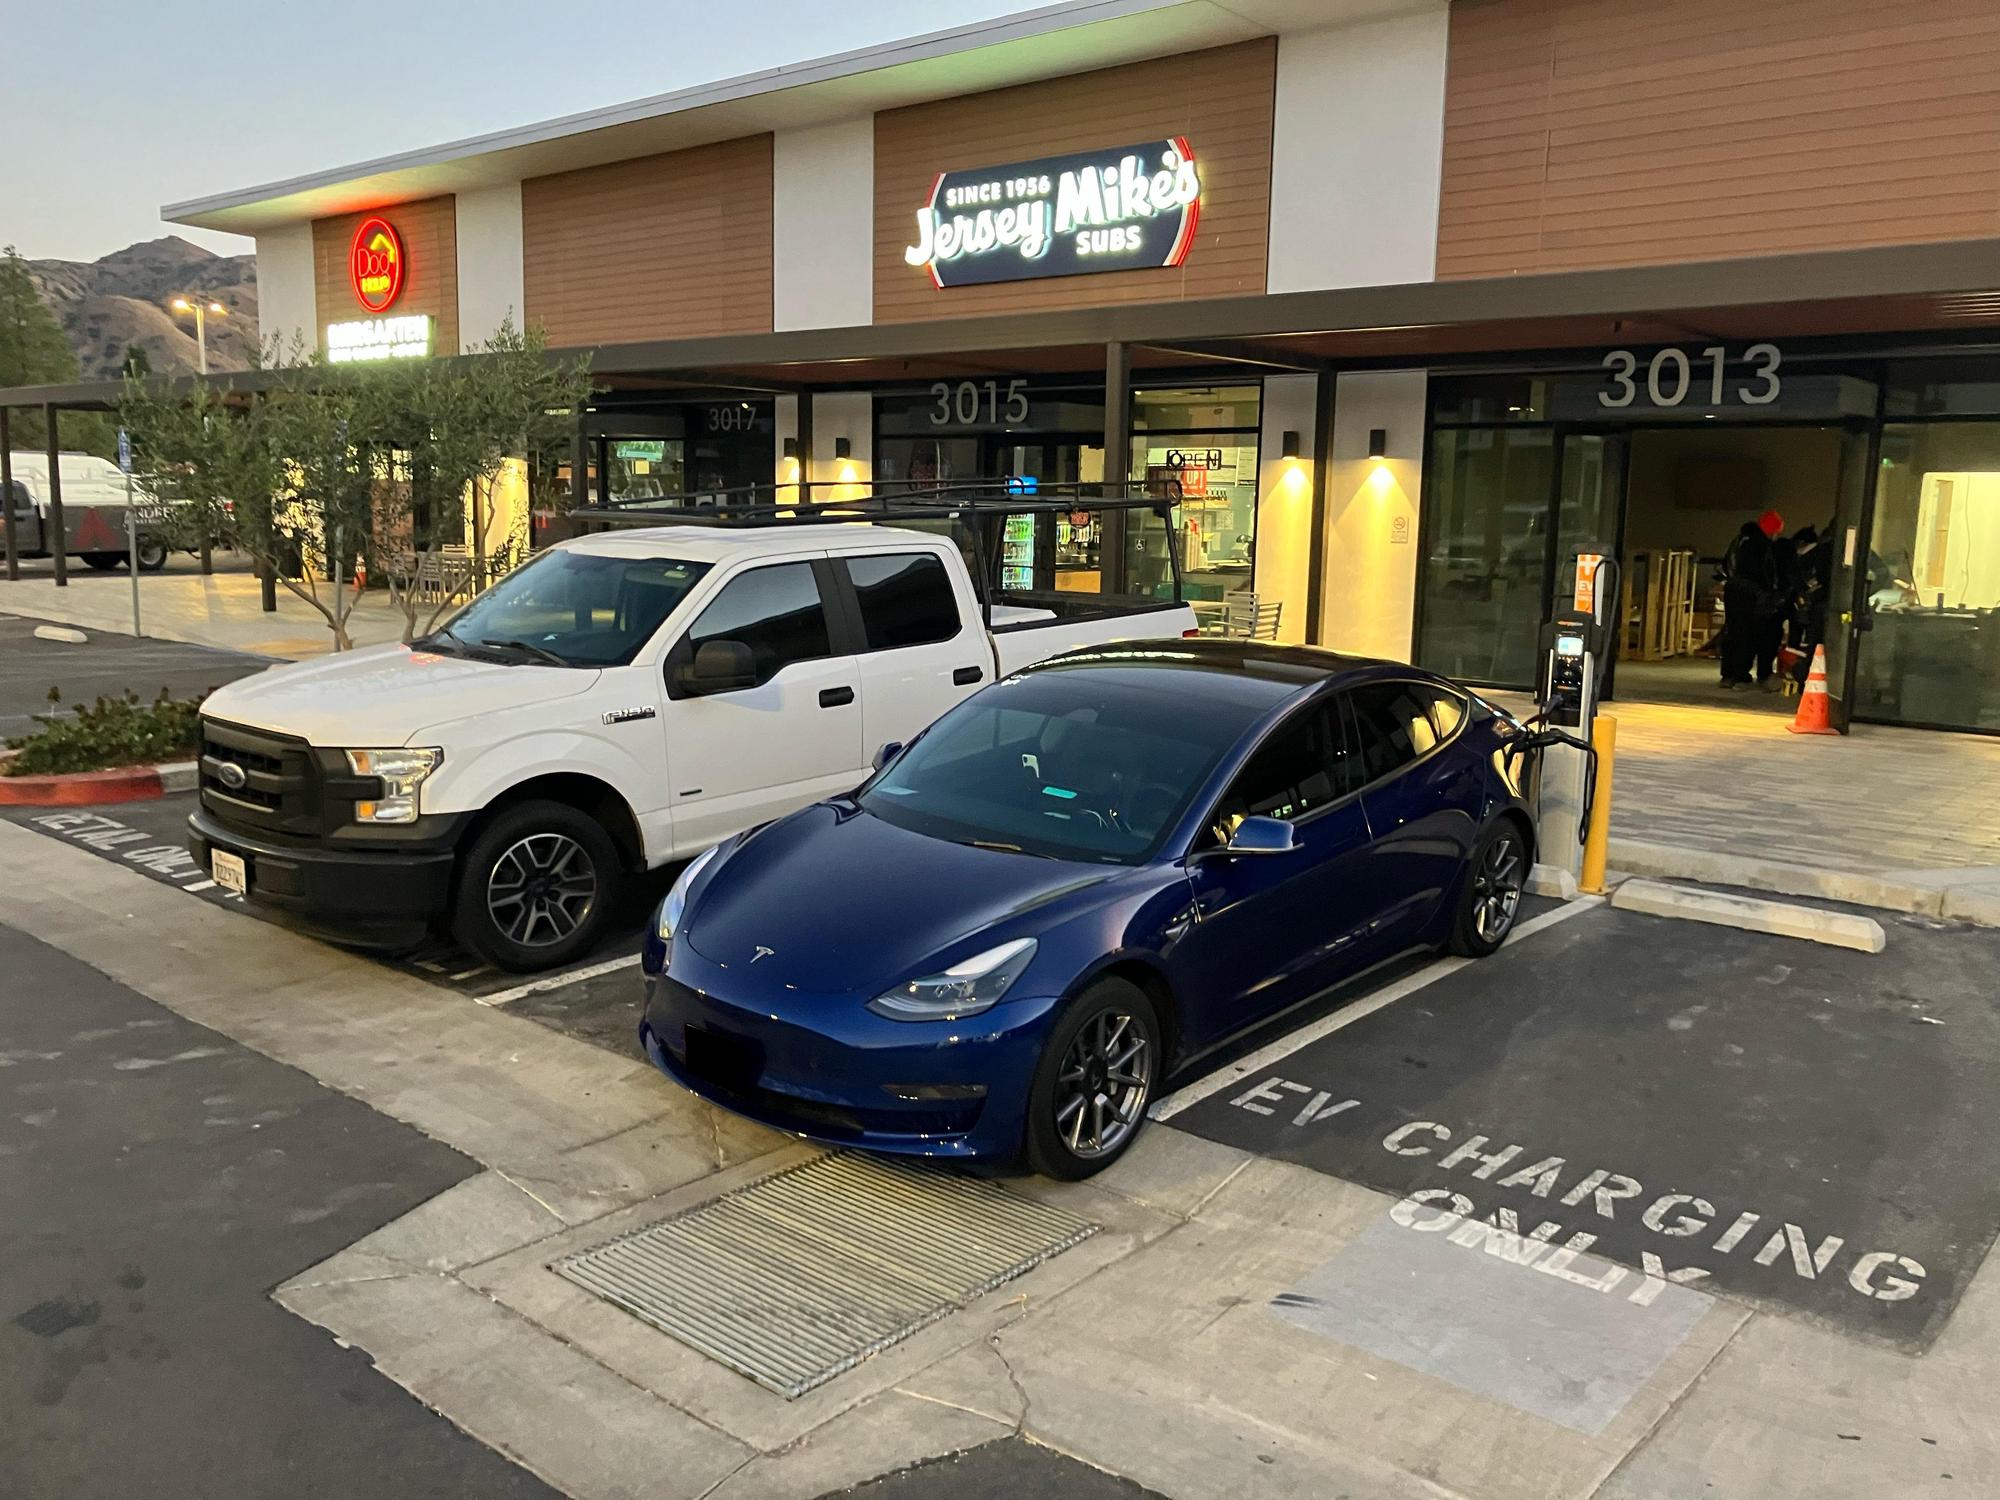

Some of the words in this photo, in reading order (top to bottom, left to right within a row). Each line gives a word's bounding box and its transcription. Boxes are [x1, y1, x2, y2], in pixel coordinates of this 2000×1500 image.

[905, 200, 1047, 266] Jersey
[1054, 150, 1199, 233] Mike's
[946, 182, 1001, 206] SINCE
[1006, 175, 1051, 199] 1956
[1075, 225, 1142, 255] SUBS
[1598, 343, 1782, 408] 3013
[708, 407, 757, 431] 3017
[929, 379, 1029, 425] 3015
[1170, 452, 1218, 468] OPEN
[1230, 1077, 1361, 1126] EV
[1382, 1121, 1927, 1301] CHARGING
